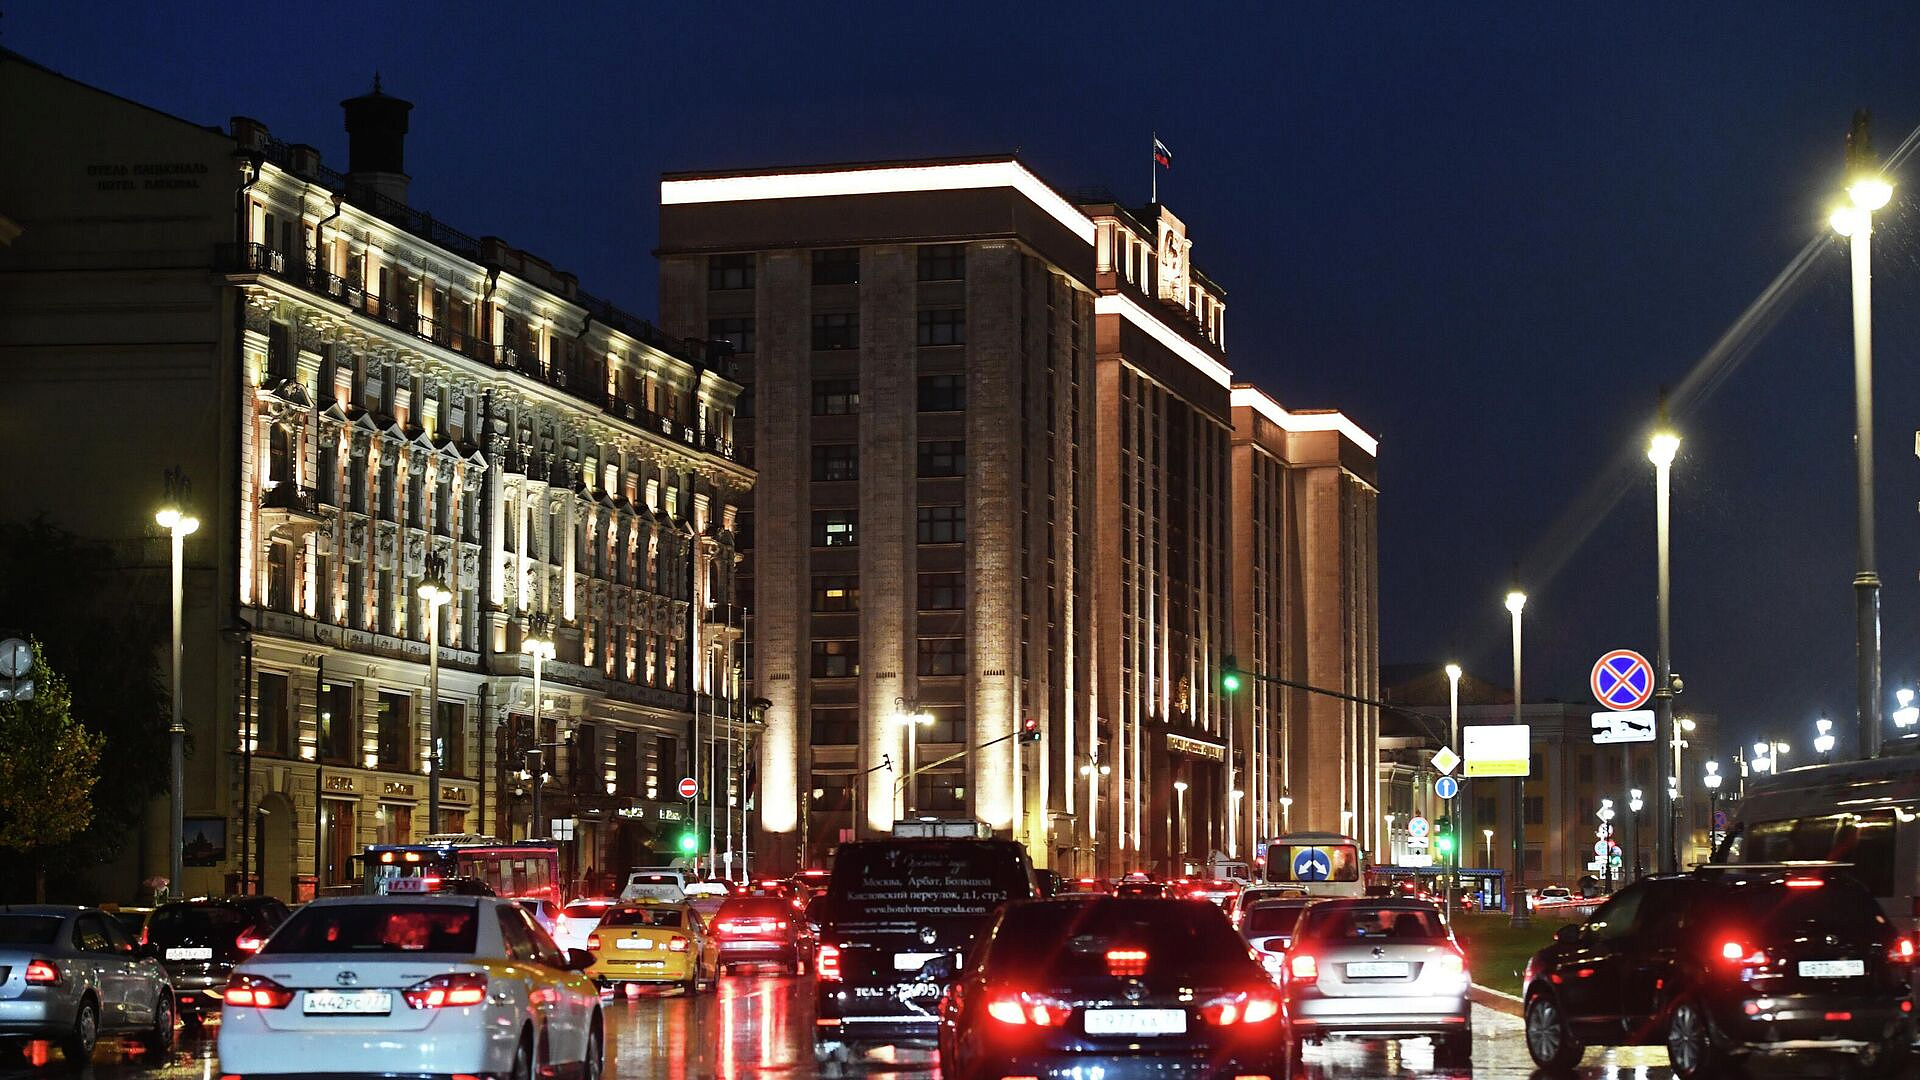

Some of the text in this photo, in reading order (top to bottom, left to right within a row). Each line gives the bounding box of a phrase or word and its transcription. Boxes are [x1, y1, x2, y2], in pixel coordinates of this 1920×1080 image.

[388, 880, 421, 890] TAXI
[908, 876, 942, 887] Арбат,
[910, 891, 960, 902] переулок,
[981, 890, 1008, 902] стр.2
